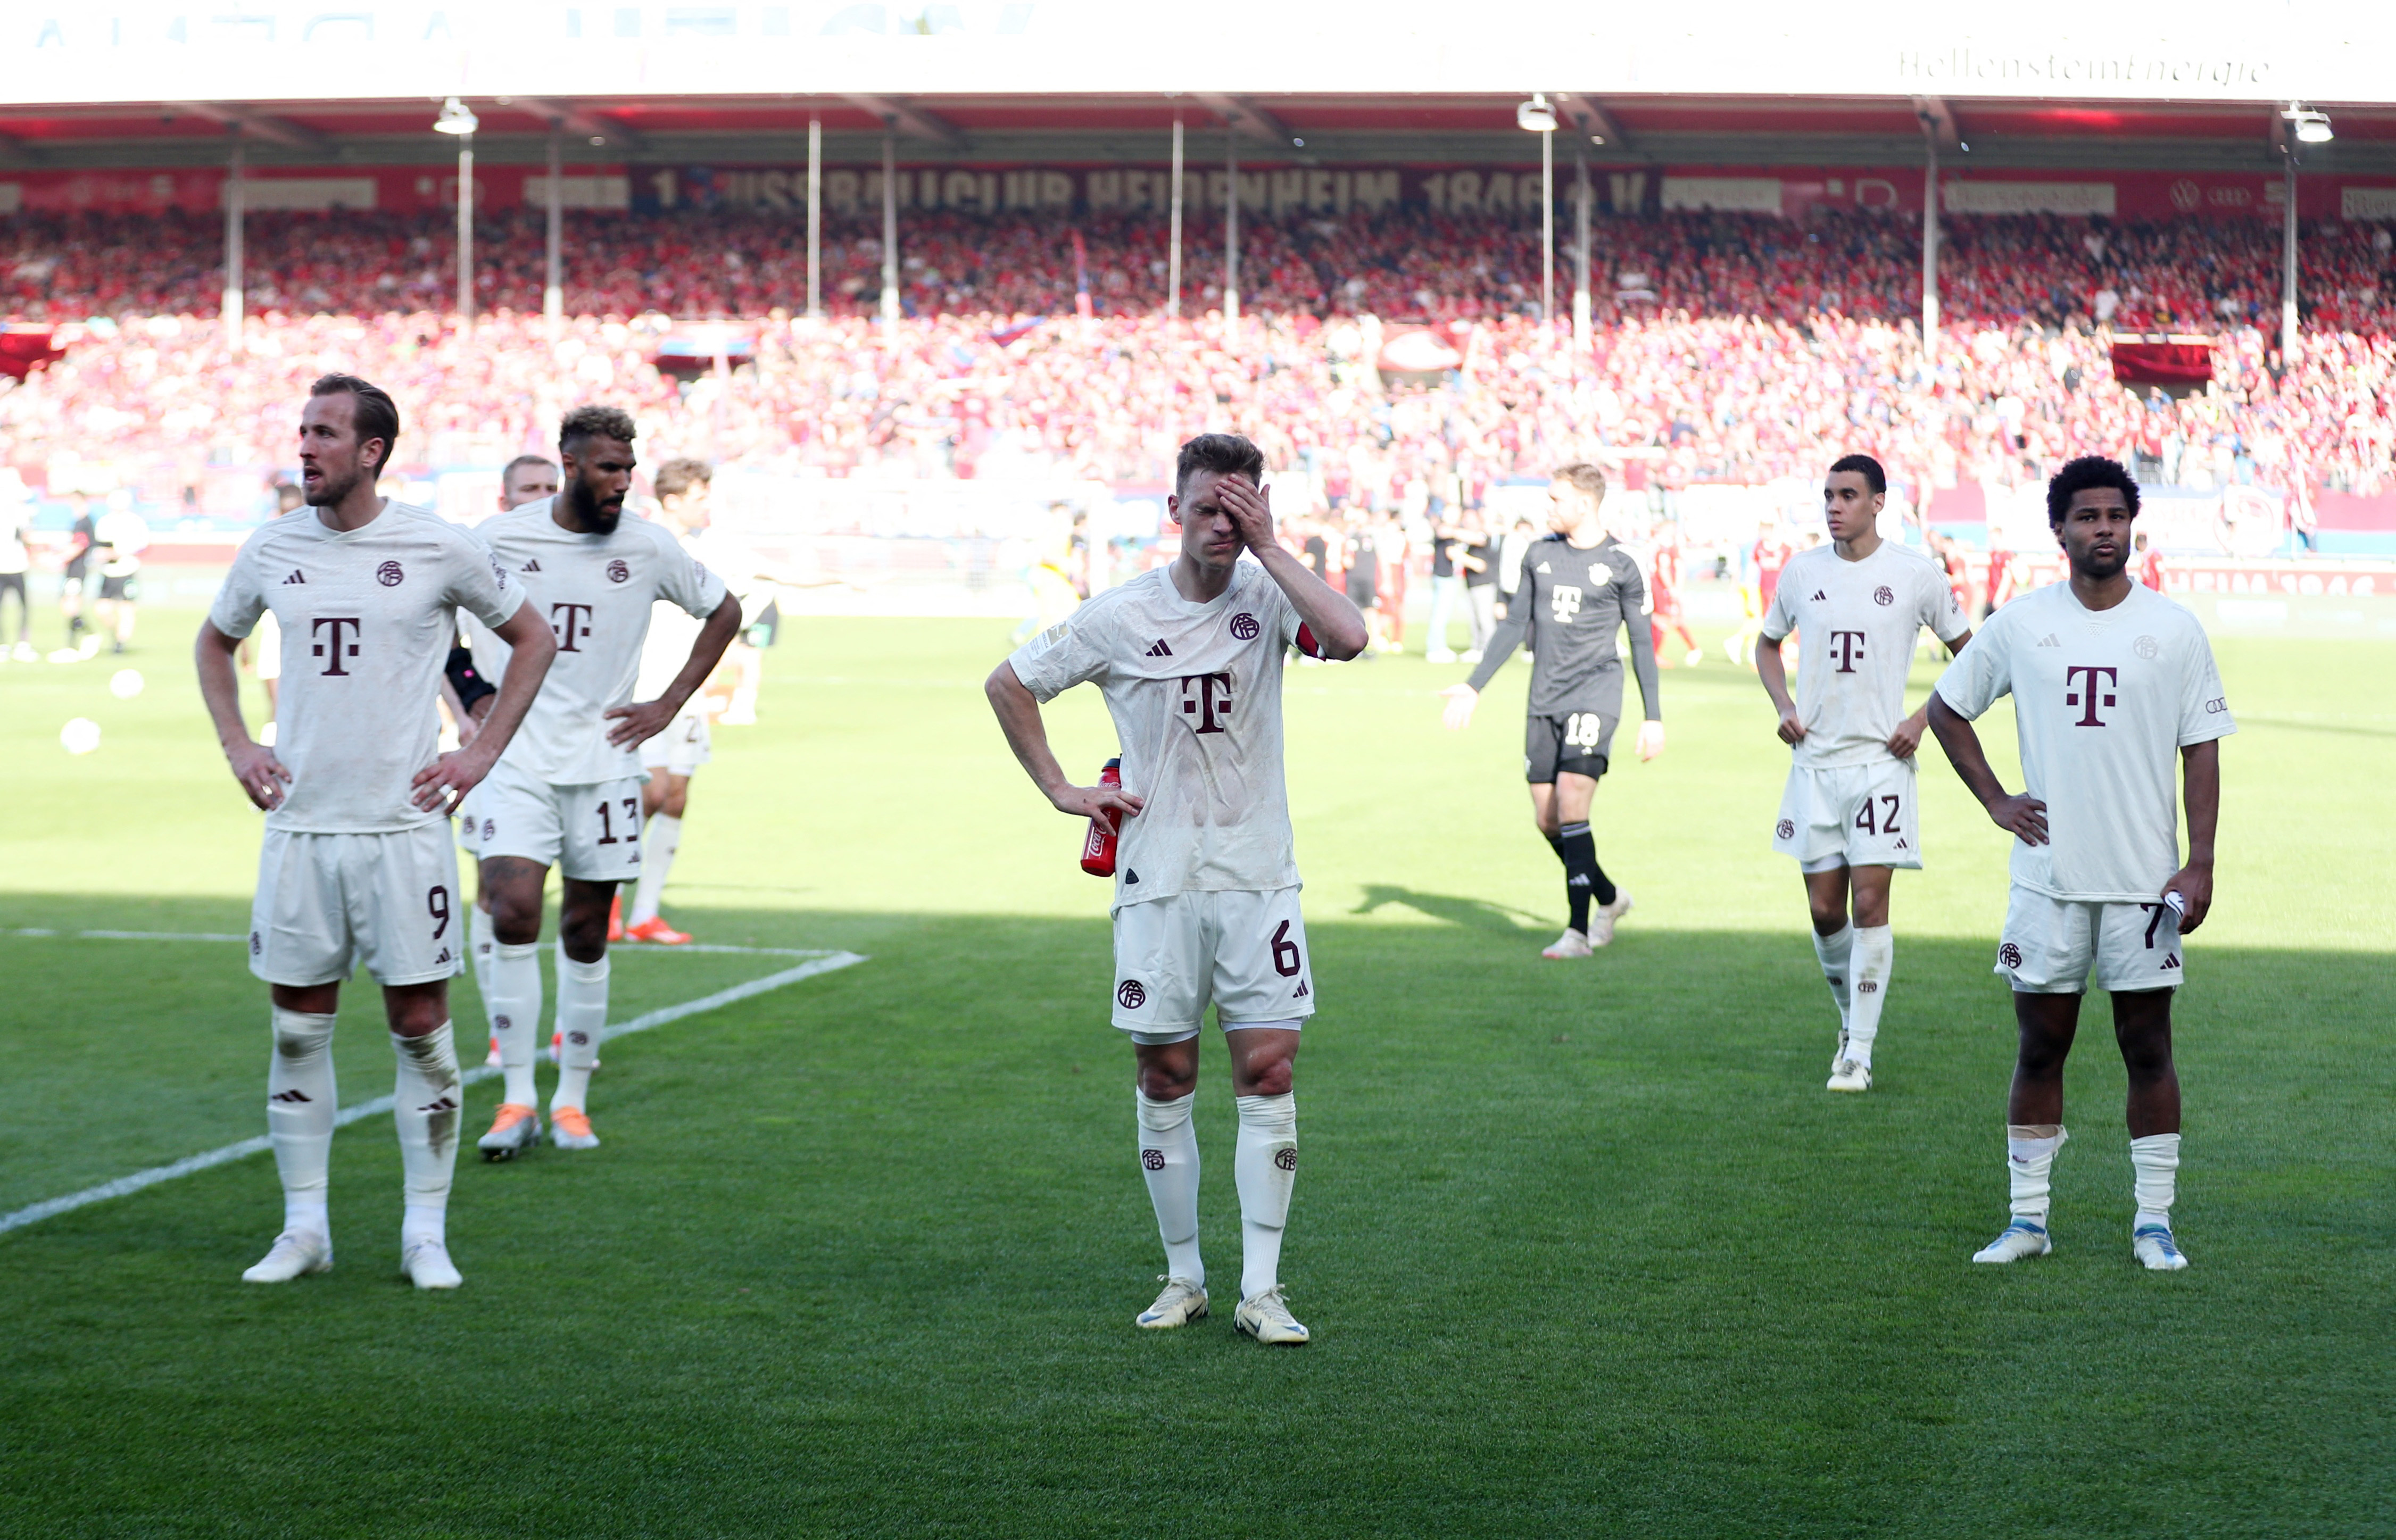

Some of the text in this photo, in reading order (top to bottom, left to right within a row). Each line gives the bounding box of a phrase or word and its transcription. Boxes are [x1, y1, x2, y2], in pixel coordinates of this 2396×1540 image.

[1564, 712, 1602, 747] 18
[595, 797, 639, 845] 13
[1856, 794, 1901, 836] 42
[428, 885, 449, 940] 9
[2140, 903, 2165, 949] 7
[1271, 919, 1301, 977] 6
